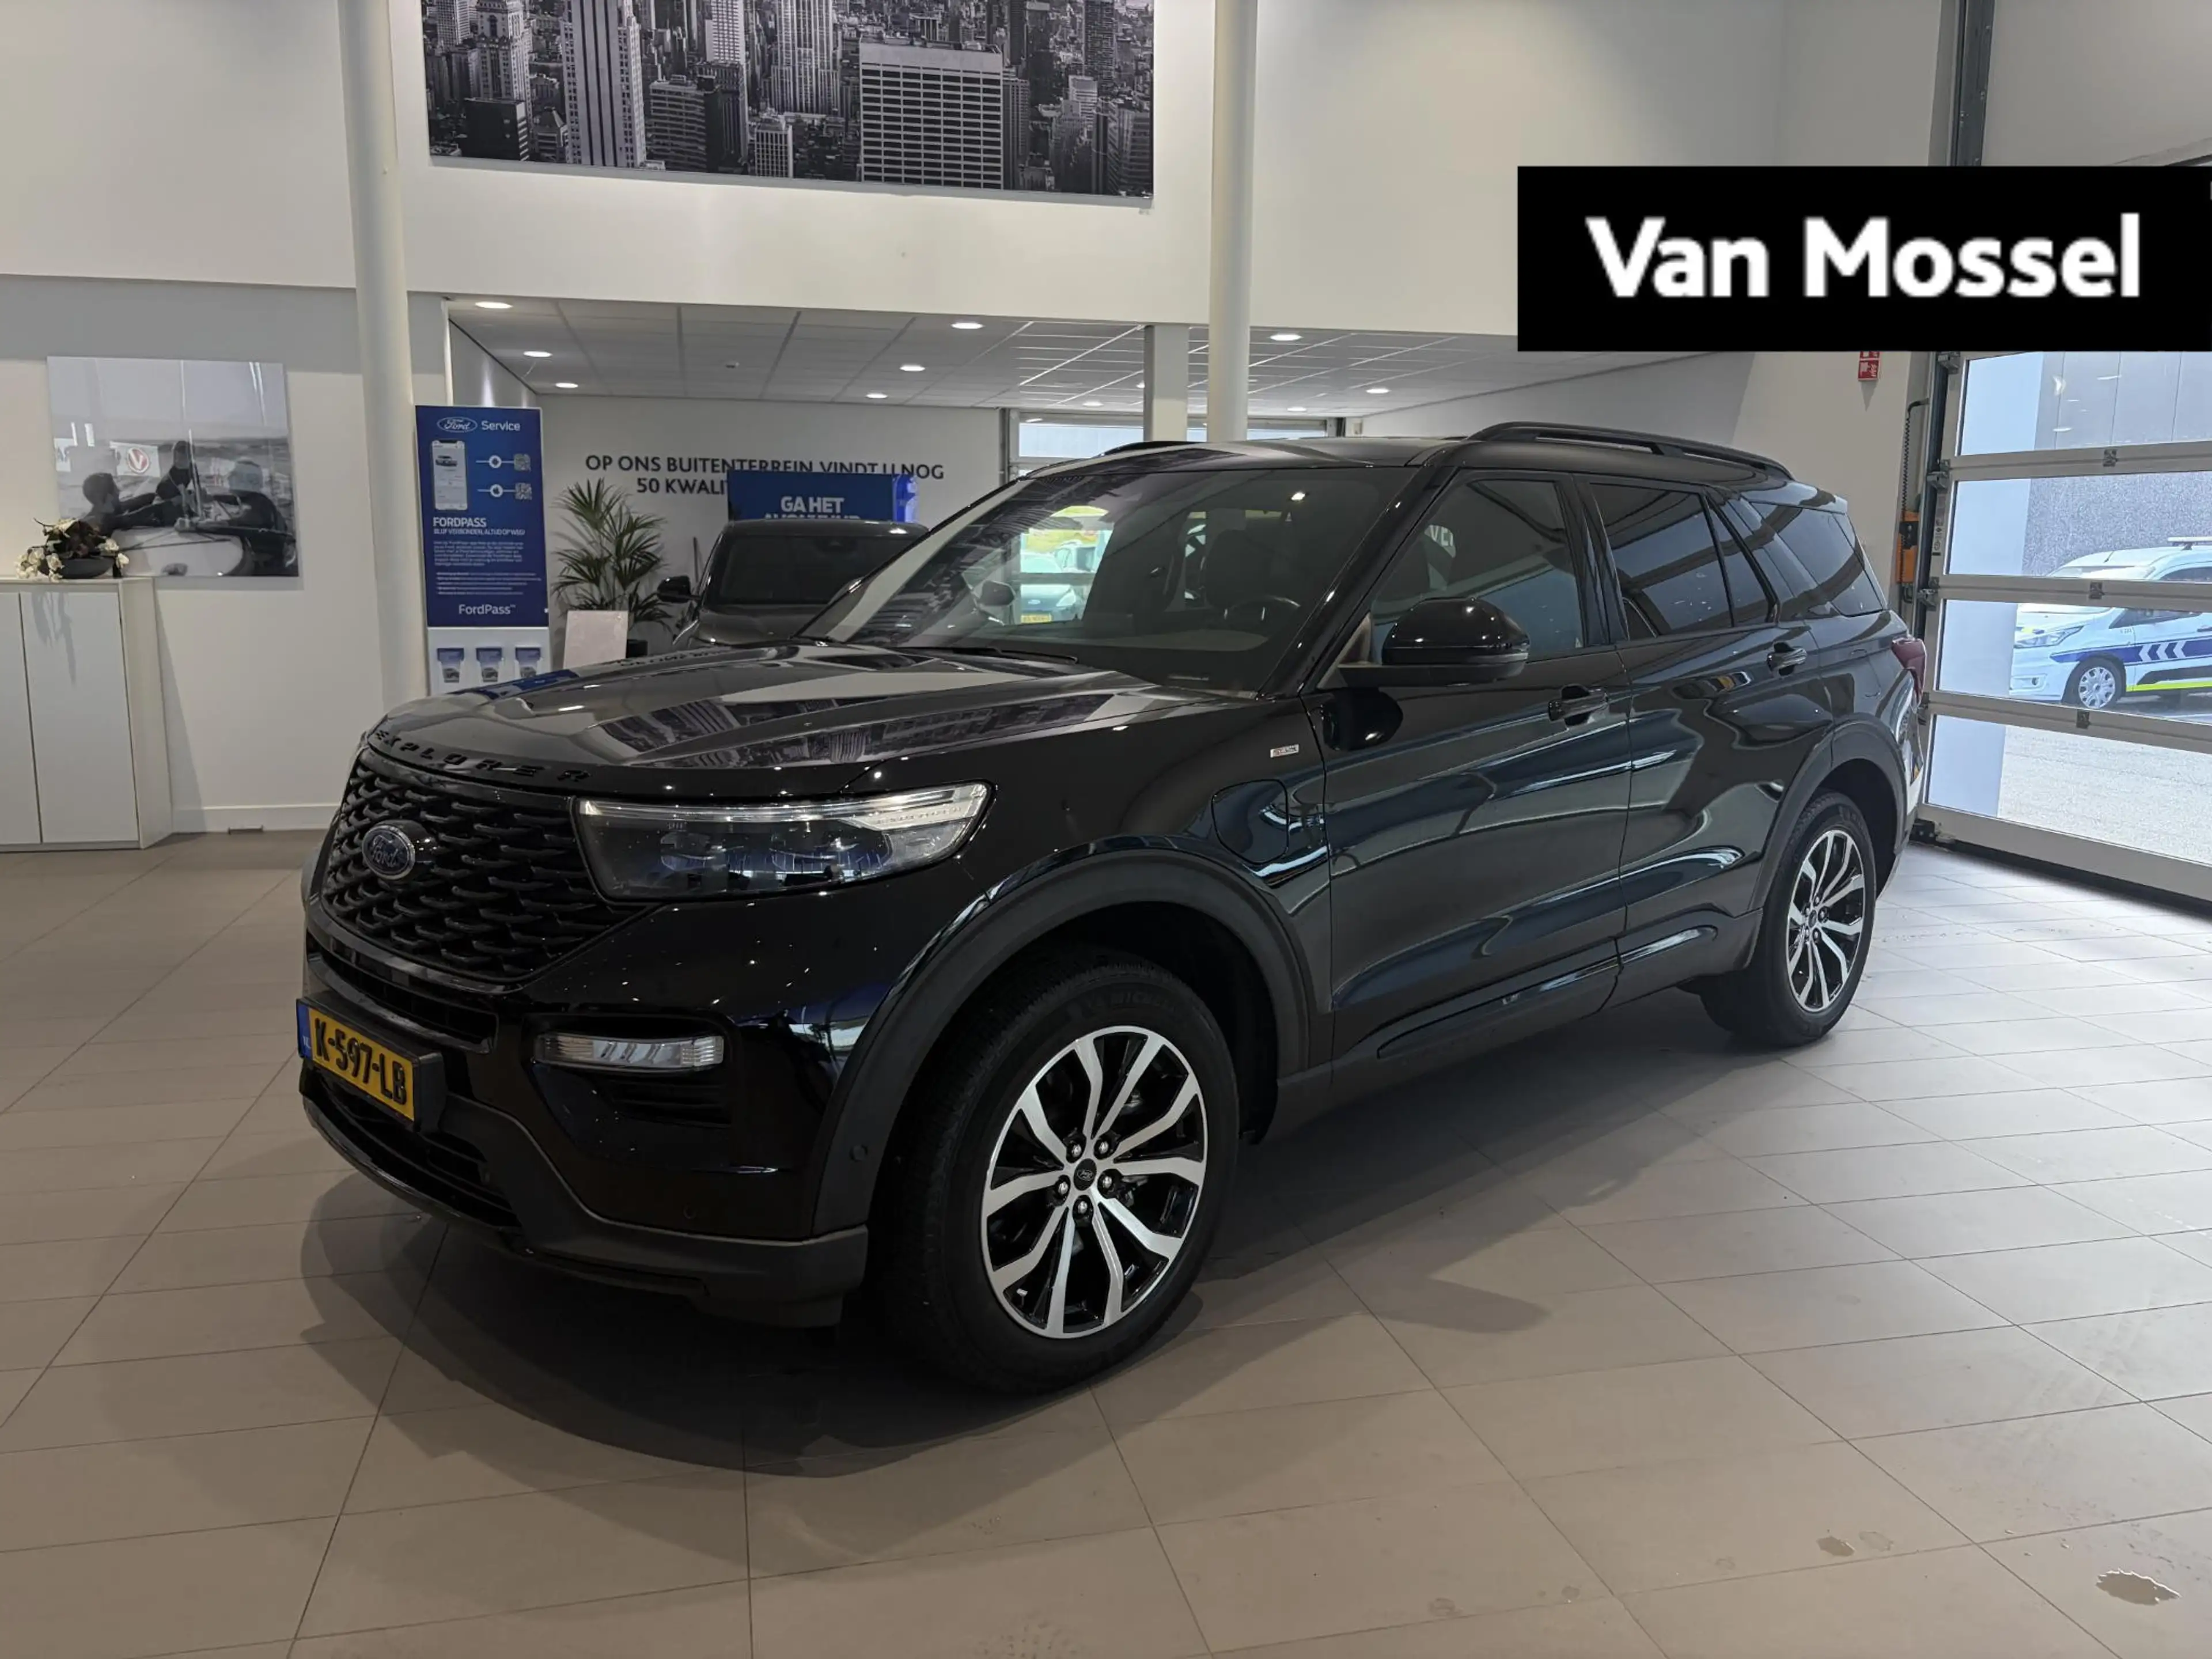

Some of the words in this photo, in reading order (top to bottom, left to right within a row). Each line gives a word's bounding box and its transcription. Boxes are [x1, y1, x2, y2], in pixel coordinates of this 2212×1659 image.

[481, 421, 521, 431] Service
[585, 454, 613, 470] OP
[618, 456, 661, 472] ONS
[667, 457, 813, 473] BUITENTERREIN
[902, 463, 945, 479] NOG
[637, 478, 660, 493] 50
[665, 479, 728, 495] KWALI
[781, 496, 806, 512] GA
[808, 497, 845, 513] HET
[433, 517, 487, 527] FORDPASS
[314, 1017, 407, 1105] K-597-LB
